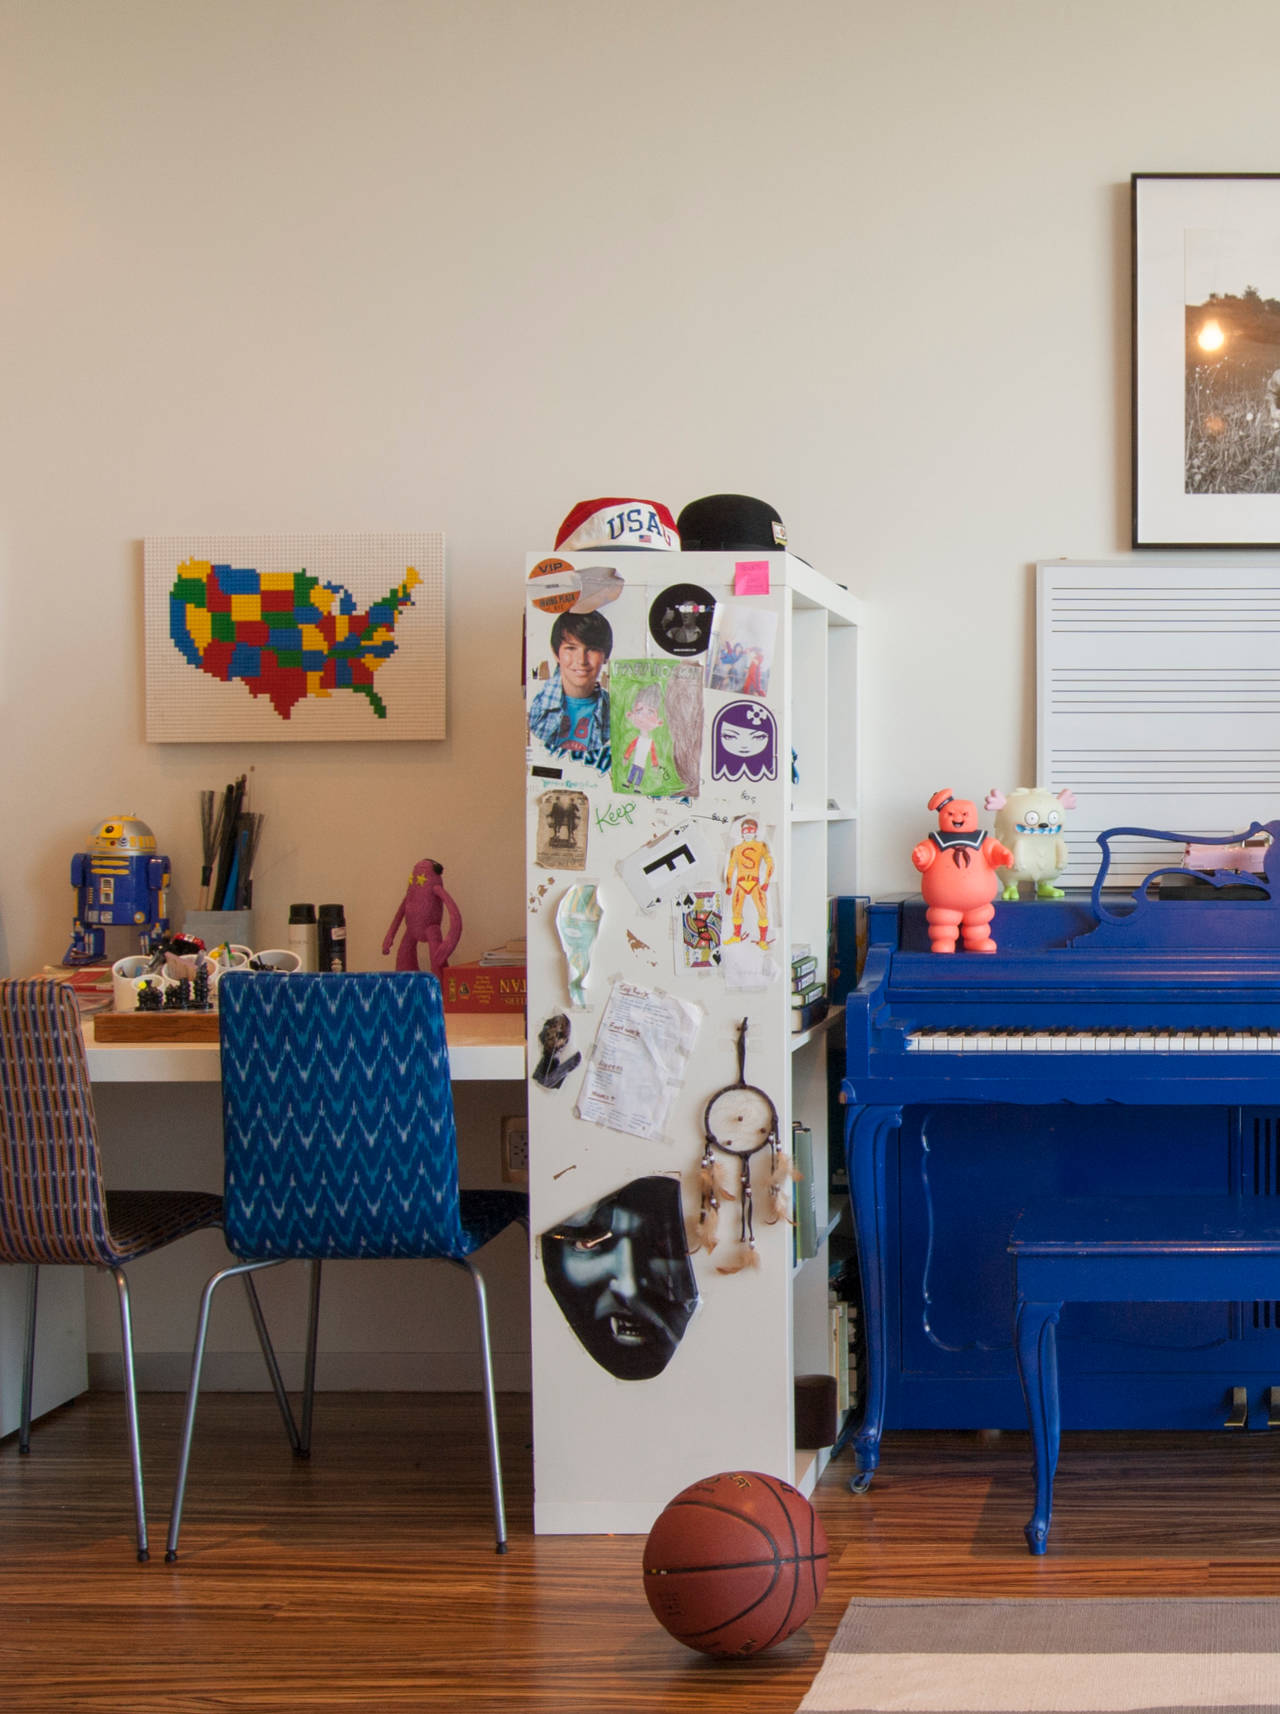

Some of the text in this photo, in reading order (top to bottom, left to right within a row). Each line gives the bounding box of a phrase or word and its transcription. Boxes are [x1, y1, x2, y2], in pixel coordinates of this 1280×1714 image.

[606, 509, 662, 540] USA
[538, 562, 563, 574] VIP
[595, 802, 637, 833] Keep
[500, 978, 527, 993] TAN
